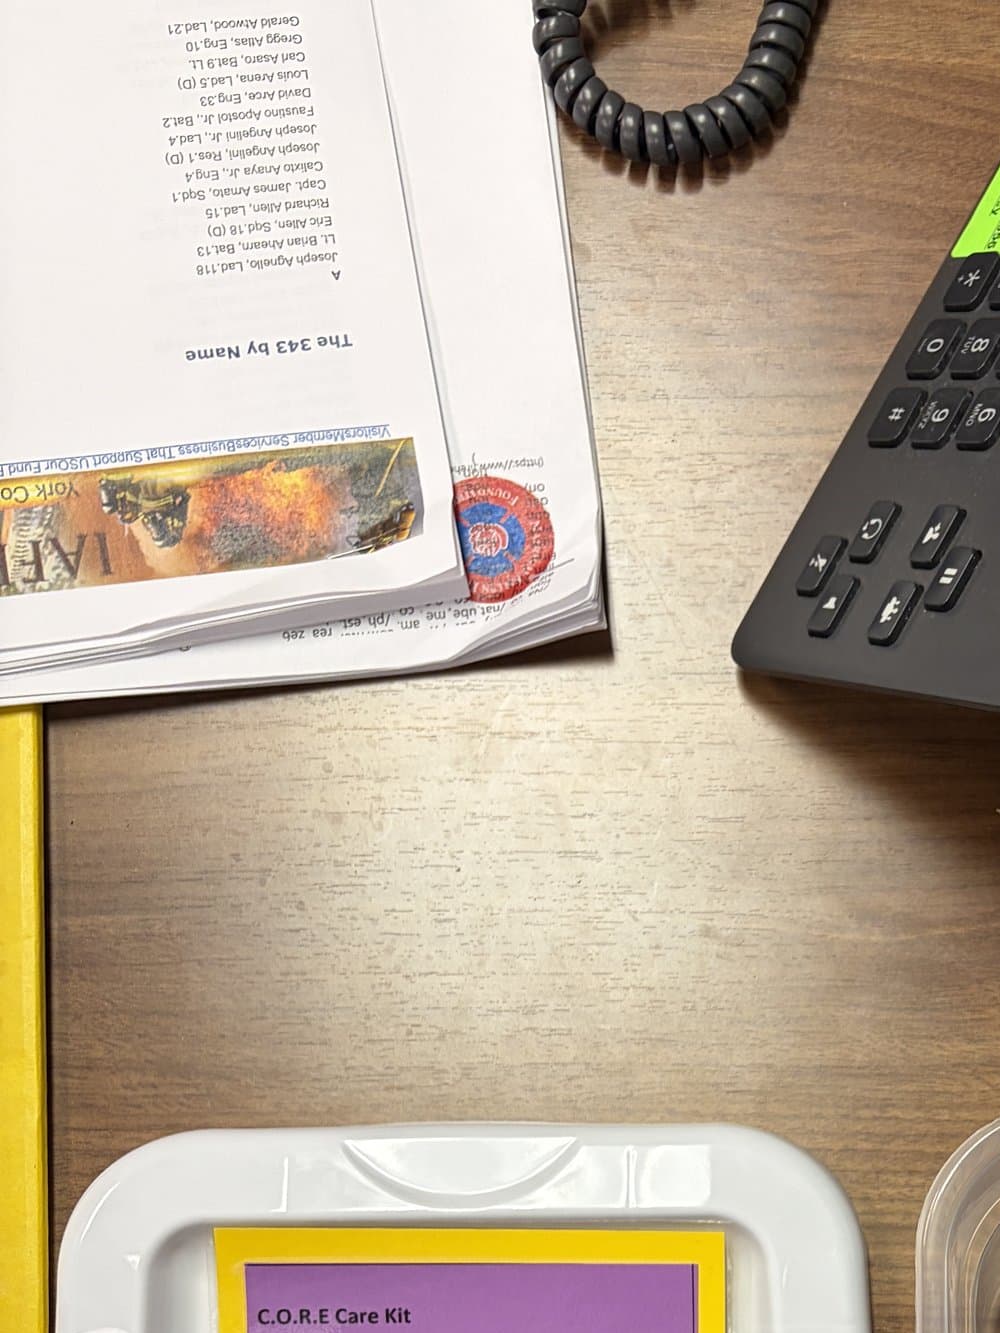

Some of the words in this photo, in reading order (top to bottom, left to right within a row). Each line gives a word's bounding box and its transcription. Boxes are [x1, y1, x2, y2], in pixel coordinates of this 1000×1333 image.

[167, 21, 207, 35] Lad.21
[210, 18, 258, 32] Atwood,
[260, 15, 300, 29] Gerald
[205, 205, 246, 219] Lad.15
[248, 201, 282, 213] Allen,
[284, 197, 330, 212] Richard
[246, 254, 294, 270] Agnello,
[295, 251, 339, 266] Joseph
[196, 261, 244, 276] Lad.118
[331, 270, 341, 281] A
[247, 340, 270, 356] by
[275, 338, 312, 354] 343
[316, 334, 353, 349] The
[926, 338, 945, 353] 0
[971, 337, 989, 352] 8
[185, 345, 241, 361] Name
[931, 408, 950, 424] 9
[978, 408, 997, 424] 6
[257, 1308, 330, 1325] C.O.R.E
[335, 1308, 379, 1324] Care
[385, 1307, 412, 1324] Kit
